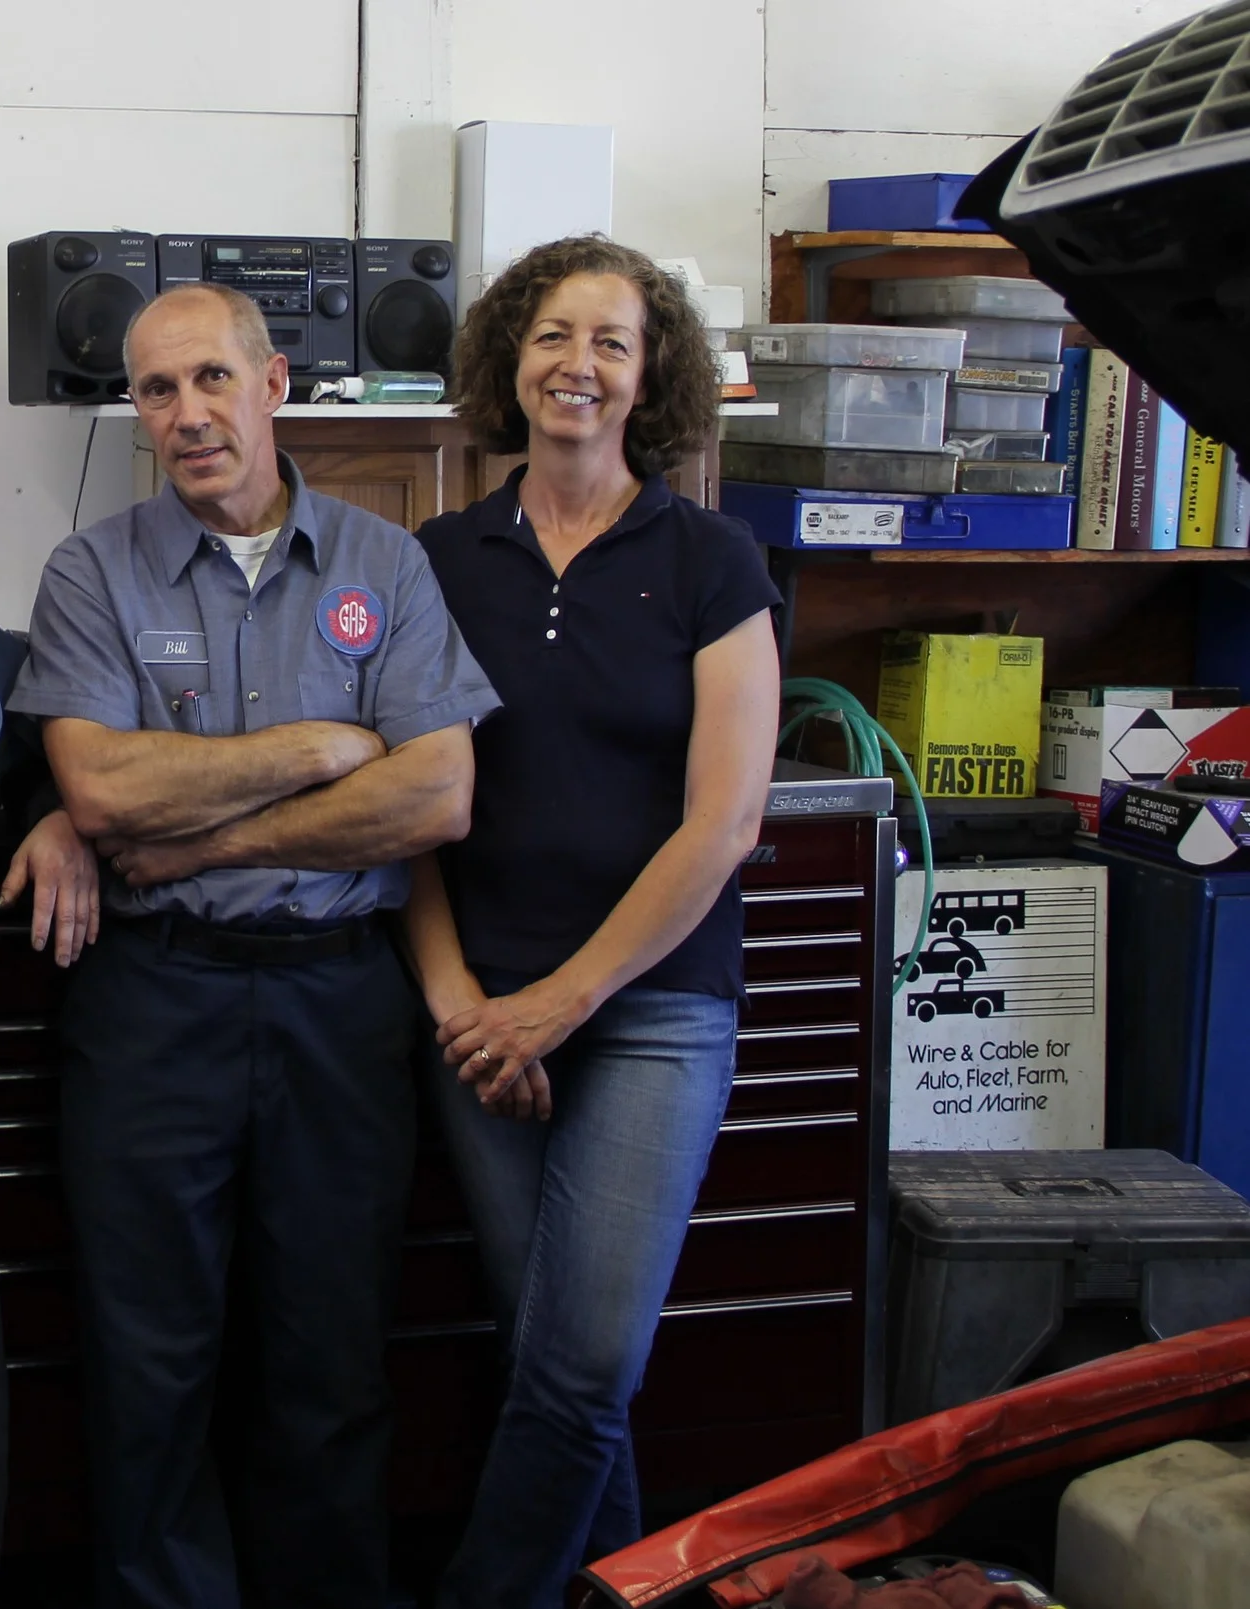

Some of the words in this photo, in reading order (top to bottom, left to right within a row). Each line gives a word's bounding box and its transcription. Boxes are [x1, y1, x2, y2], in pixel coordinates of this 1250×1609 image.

[1105, 422, 1115, 447] YOU
[1134, 408, 1150, 469] General
[1130, 474, 1145, 528] Motors
[338, 601, 368, 638] GAS
[163, 640, 188, 655] Bill
[927, 742, 969, 756] Removes
[971, 742, 985, 756] Tar
[986, 747, 992, 756] &
[993, 743, 1017, 758] Bugs
[925, 756, 1025, 795] FASTER
[1126, 805, 1150, 817] IMPACT
[1150, 810, 1178, 826] WRENCH
[1141, 798, 1161, 811] HEAVY
[1162, 803, 1180, 815] DUTY
[1138, 818, 1167, 835] CLUTCH)
[907, 1044, 957, 1063] Wire
[961, 1044, 974, 1061] &
[979, 1040, 1039, 1061] Cable
[1045, 1039, 1071, 1057] for
[916, 1070, 963, 1091] Auto,
[966, 1068, 1013, 1088] Fleet,
[1017, 1066, 1069, 1085] Farm,
[933, 1095, 972, 1115] and
[977, 1092, 1048, 1113] Marine
